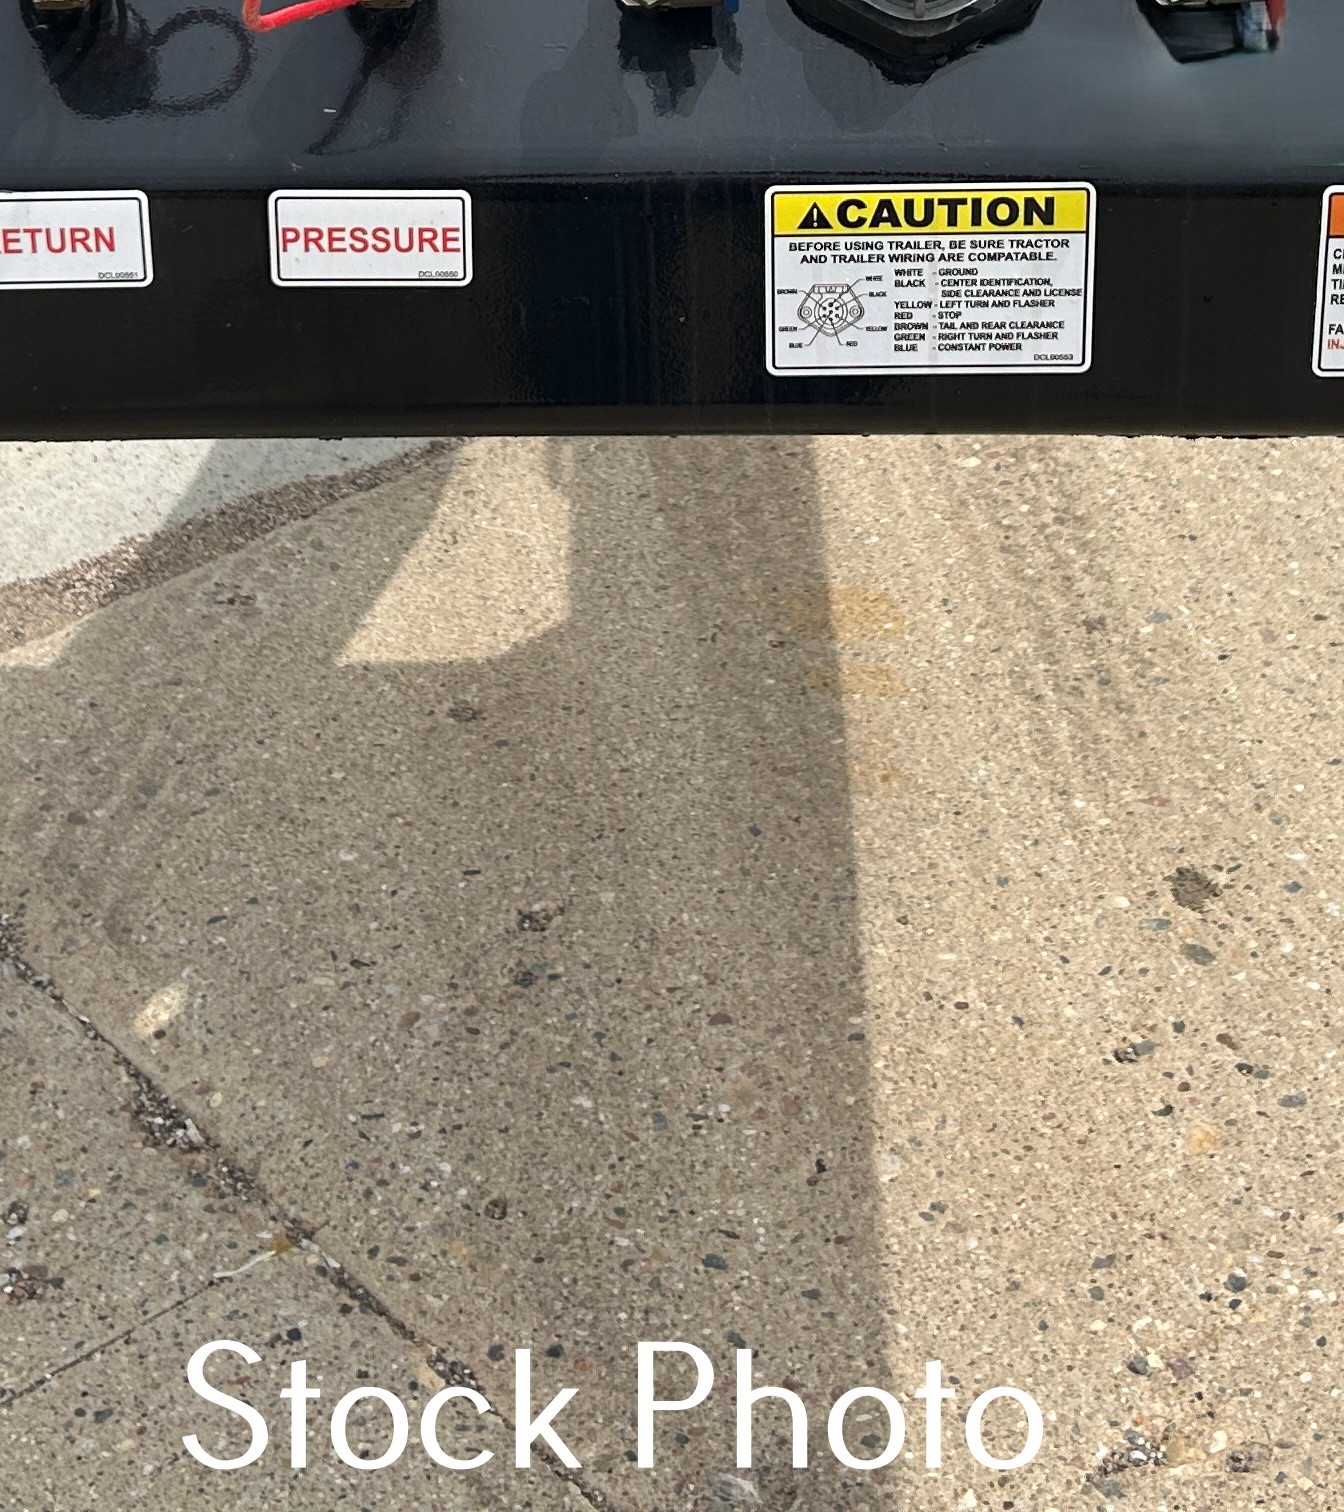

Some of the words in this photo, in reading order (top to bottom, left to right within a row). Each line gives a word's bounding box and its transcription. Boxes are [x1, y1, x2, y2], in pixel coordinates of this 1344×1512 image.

[837, 197, 1055, 228] CAUTION
[282, 227, 461, 253] PRESSURE
[789, 242, 841, 251] BEFORE
[845, 241, 883, 250] USING
[887, 240, 946, 251] TRAILER,
[950, 240, 967, 249] BE
[970, 240, 1005, 249] SURE
[1008, 239, 1070, 248] TRACTOR
[800, 254, 827, 263] AND
[832, 254, 885, 263] TRAILER
[888, 253, 935, 263] WIRING
[938, 253, 965, 262] ARE
[968, 252, 1057, 261] COMPATABLE.
